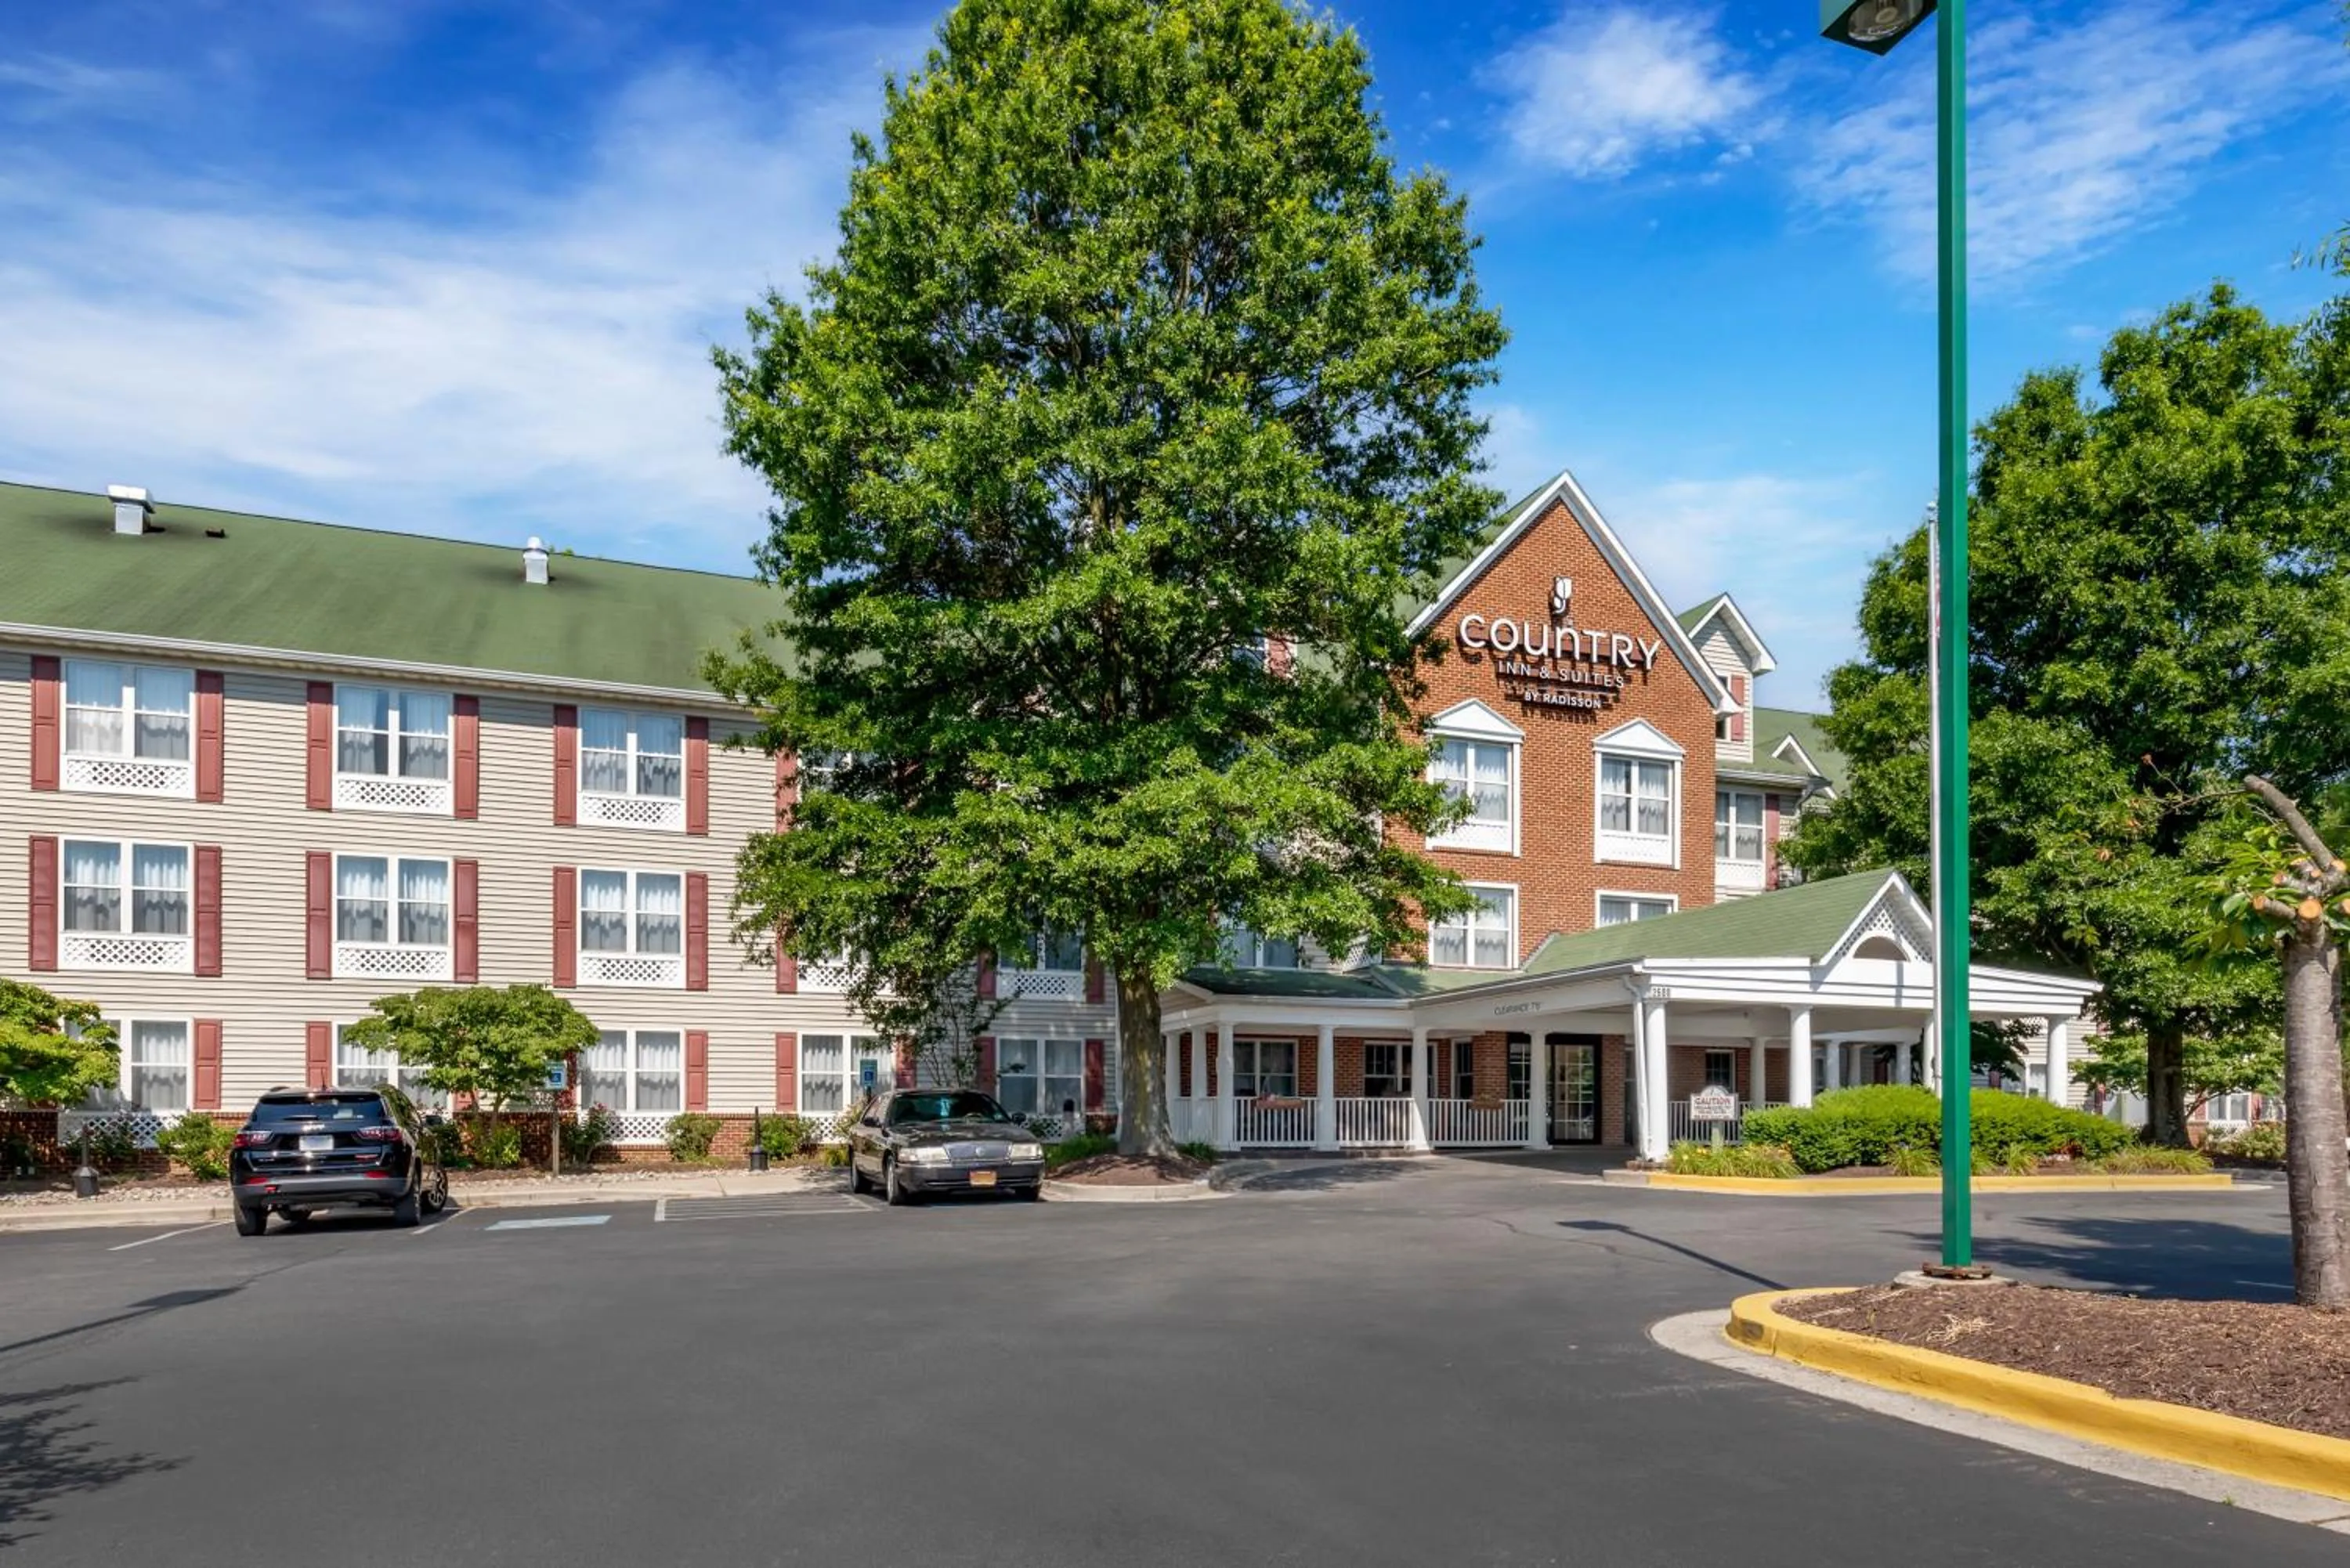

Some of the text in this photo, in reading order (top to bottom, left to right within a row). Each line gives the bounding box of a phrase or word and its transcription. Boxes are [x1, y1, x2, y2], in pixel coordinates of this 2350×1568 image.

[1459, 614, 1661, 670] COUNTRY
[1498, 660, 1624, 688] INN & SUITES
[1524, 692, 1601, 708] BY RADISSON
